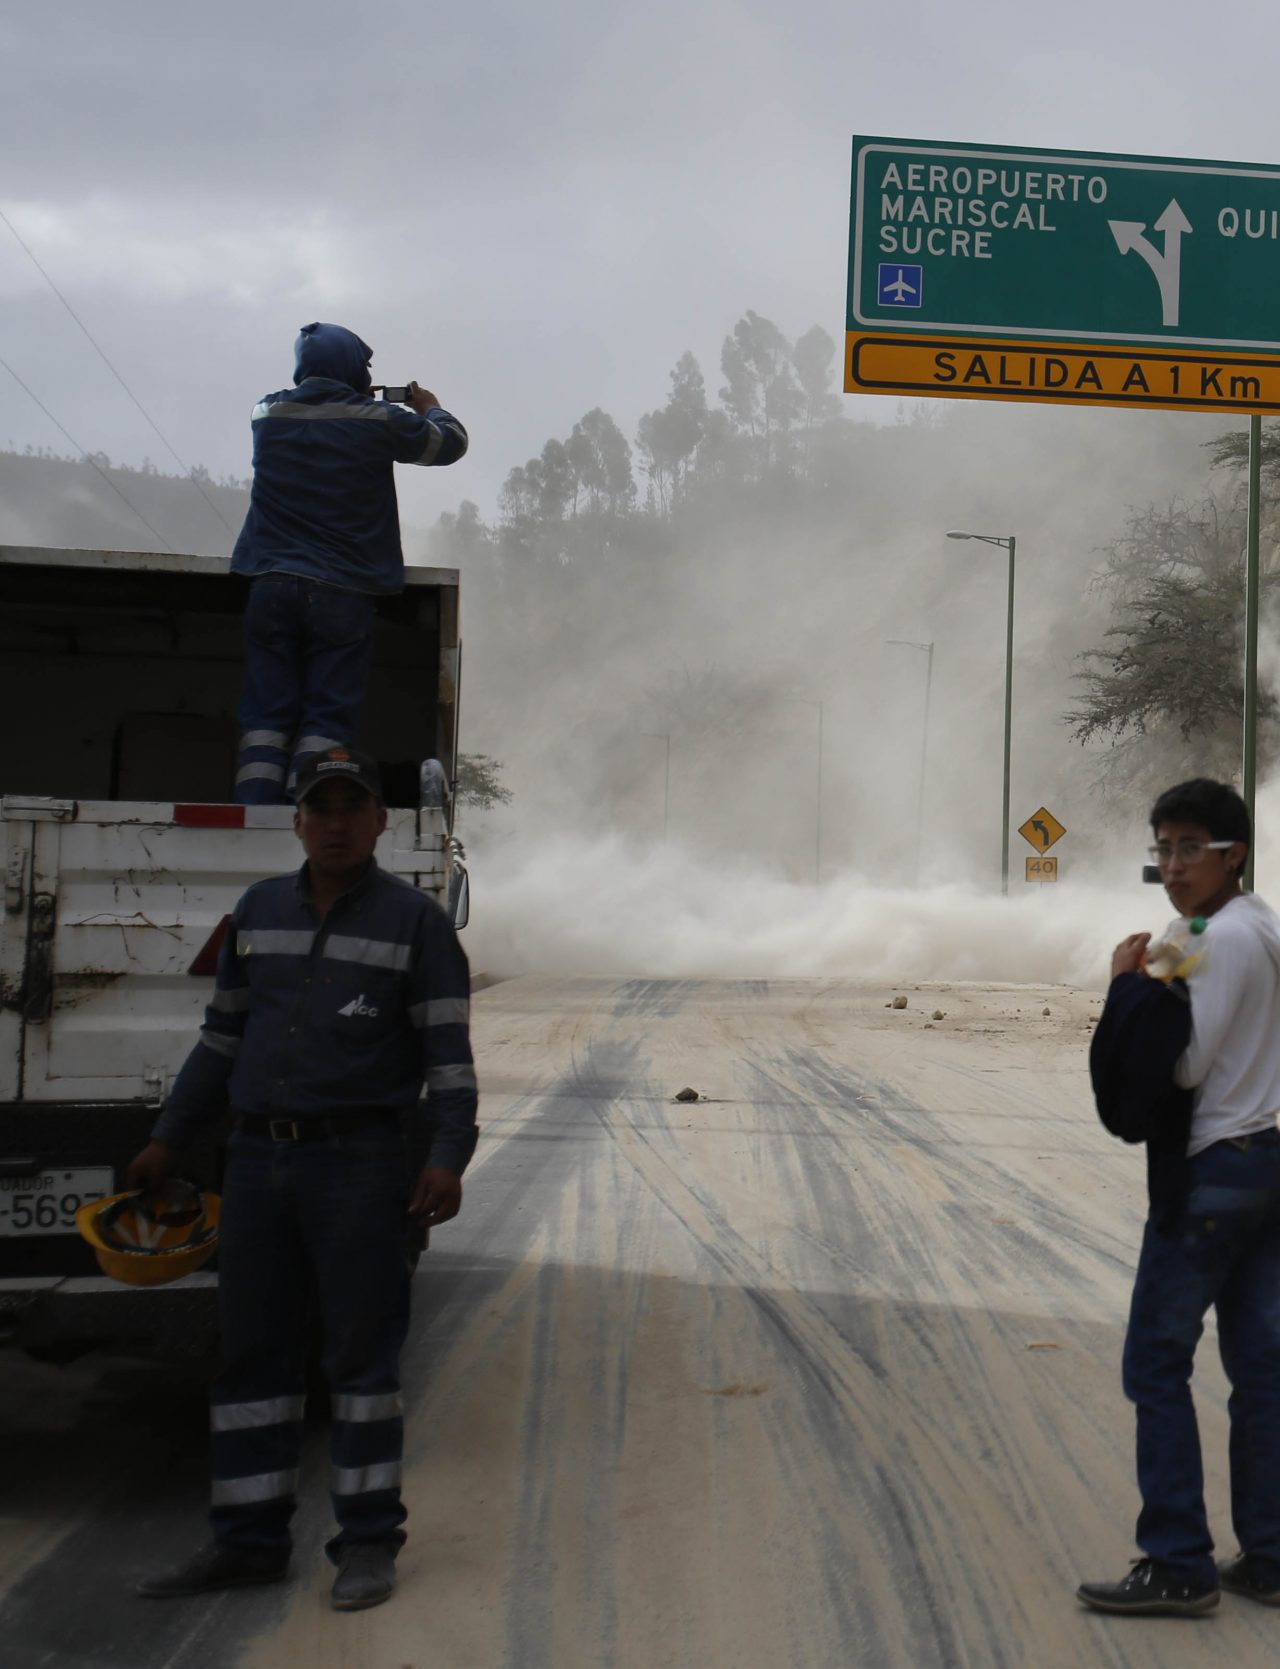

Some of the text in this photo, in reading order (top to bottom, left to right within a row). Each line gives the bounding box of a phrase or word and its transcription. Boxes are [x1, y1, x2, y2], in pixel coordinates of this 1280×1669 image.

[880, 162, 1108, 204] AEROPUERTO
[881, 193, 1057, 232] MARISCAL
[879, 225, 993, 259] SUCRE
[933, 352, 1261, 399] SALIDA A 1 Km
[1030, 861, 1054, 874] 40
